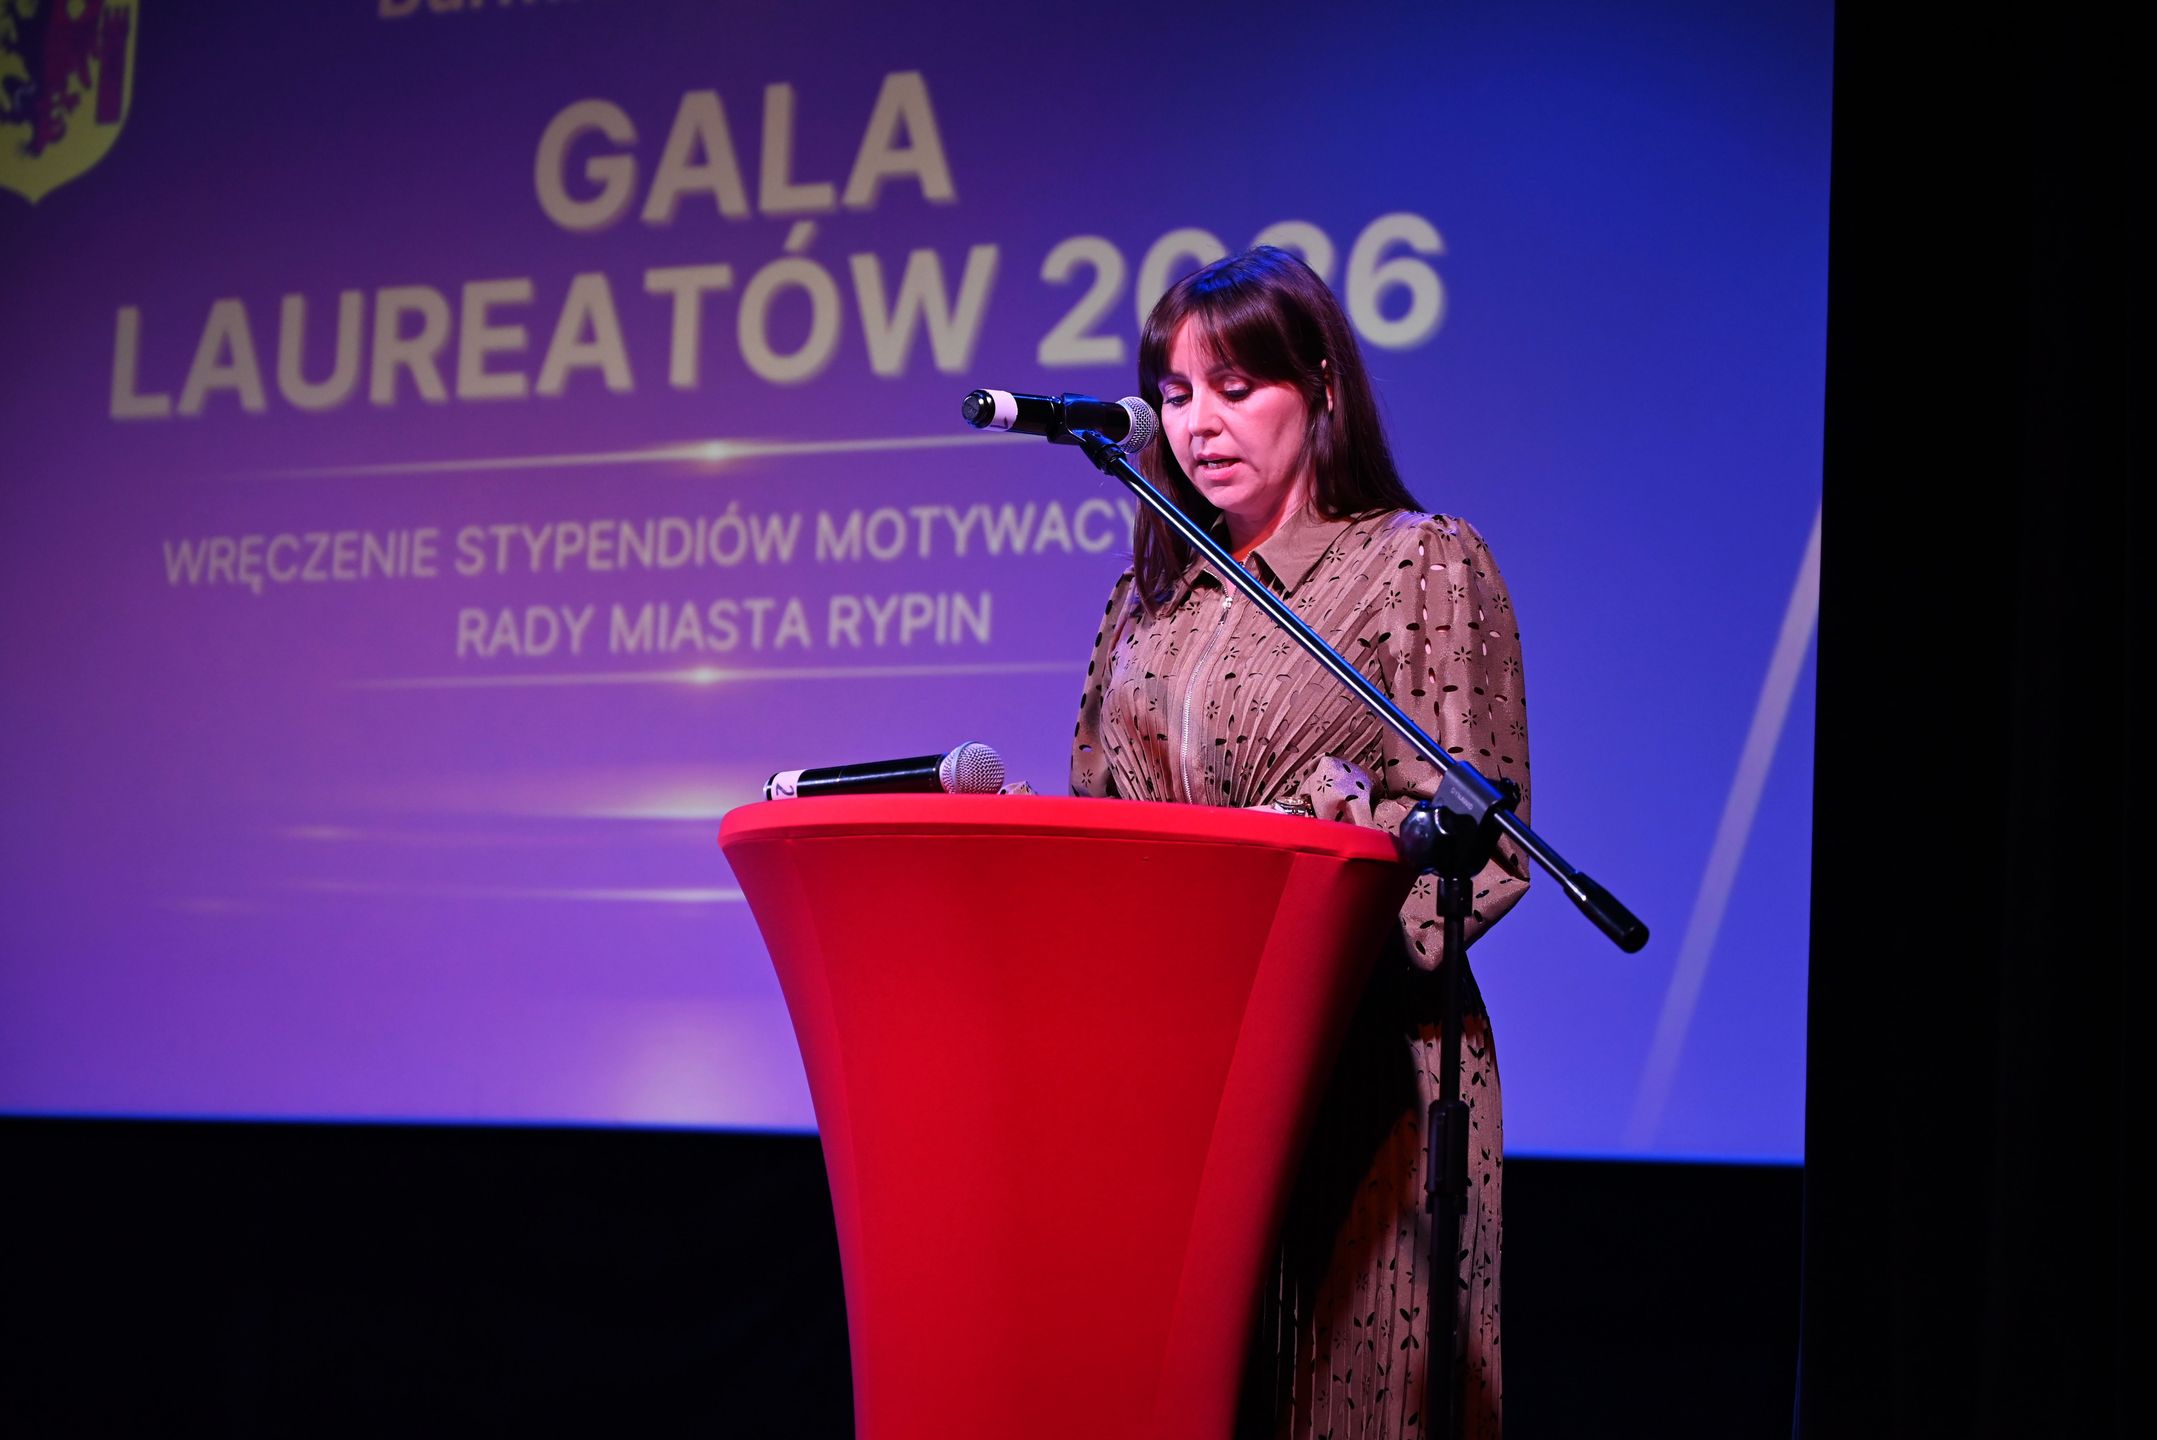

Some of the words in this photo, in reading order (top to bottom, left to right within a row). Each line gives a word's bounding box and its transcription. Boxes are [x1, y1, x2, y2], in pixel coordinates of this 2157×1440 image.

[534, 70, 956, 230] GALA
[109, 220, 998, 419] LAUREATÓW
[162, 526, 440, 595] WRĘCZENIE
[454, 501, 803, 576] STYPENDIÓW
[456, 603, 596, 657] RADY
[608, 597, 812, 653] MIASTA
[827, 592, 993, 647] RYPIN
[776, 783, 794, 796] 2
